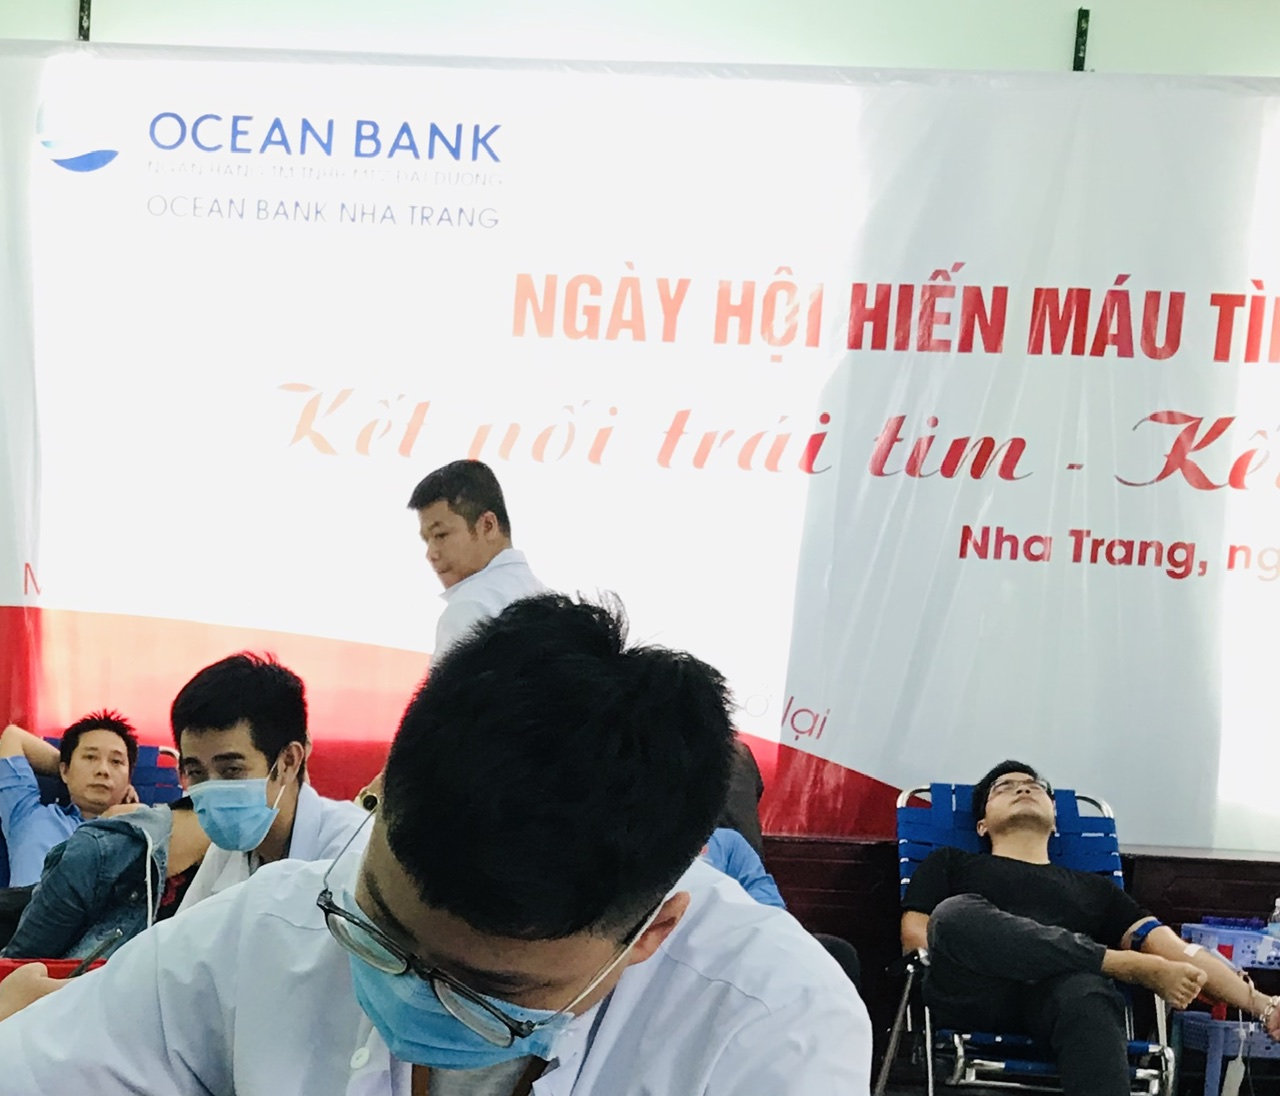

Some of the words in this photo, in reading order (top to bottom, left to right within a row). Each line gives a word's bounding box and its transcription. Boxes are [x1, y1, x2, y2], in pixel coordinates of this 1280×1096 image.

[148, 111, 335, 157] OCEAN
[353, 119, 503, 163] BANK
[146, 194, 245, 220] OCEAN
[255, 199, 328, 223] BANK
[339, 202, 397, 225] NHA
[408, 205, 500, 230] TRANG
[512, 261, 692, 343] NGÀY
[713, 266, 824, 363] HỘI
[846, 262, 1009, 355] HIẾN
[1027, 274, 1187, 361] MÁU
[276, 381, 432, 460] Kết
[466, 399, 620, 466] nối
[656, 408, 832, 476] trái
[867, 413, 1034, 482] tim
[958, 524, 1052, 563] Nha
[1068, 529, 1208, 580] Trang,
[780, 694, 832, 742] lại
